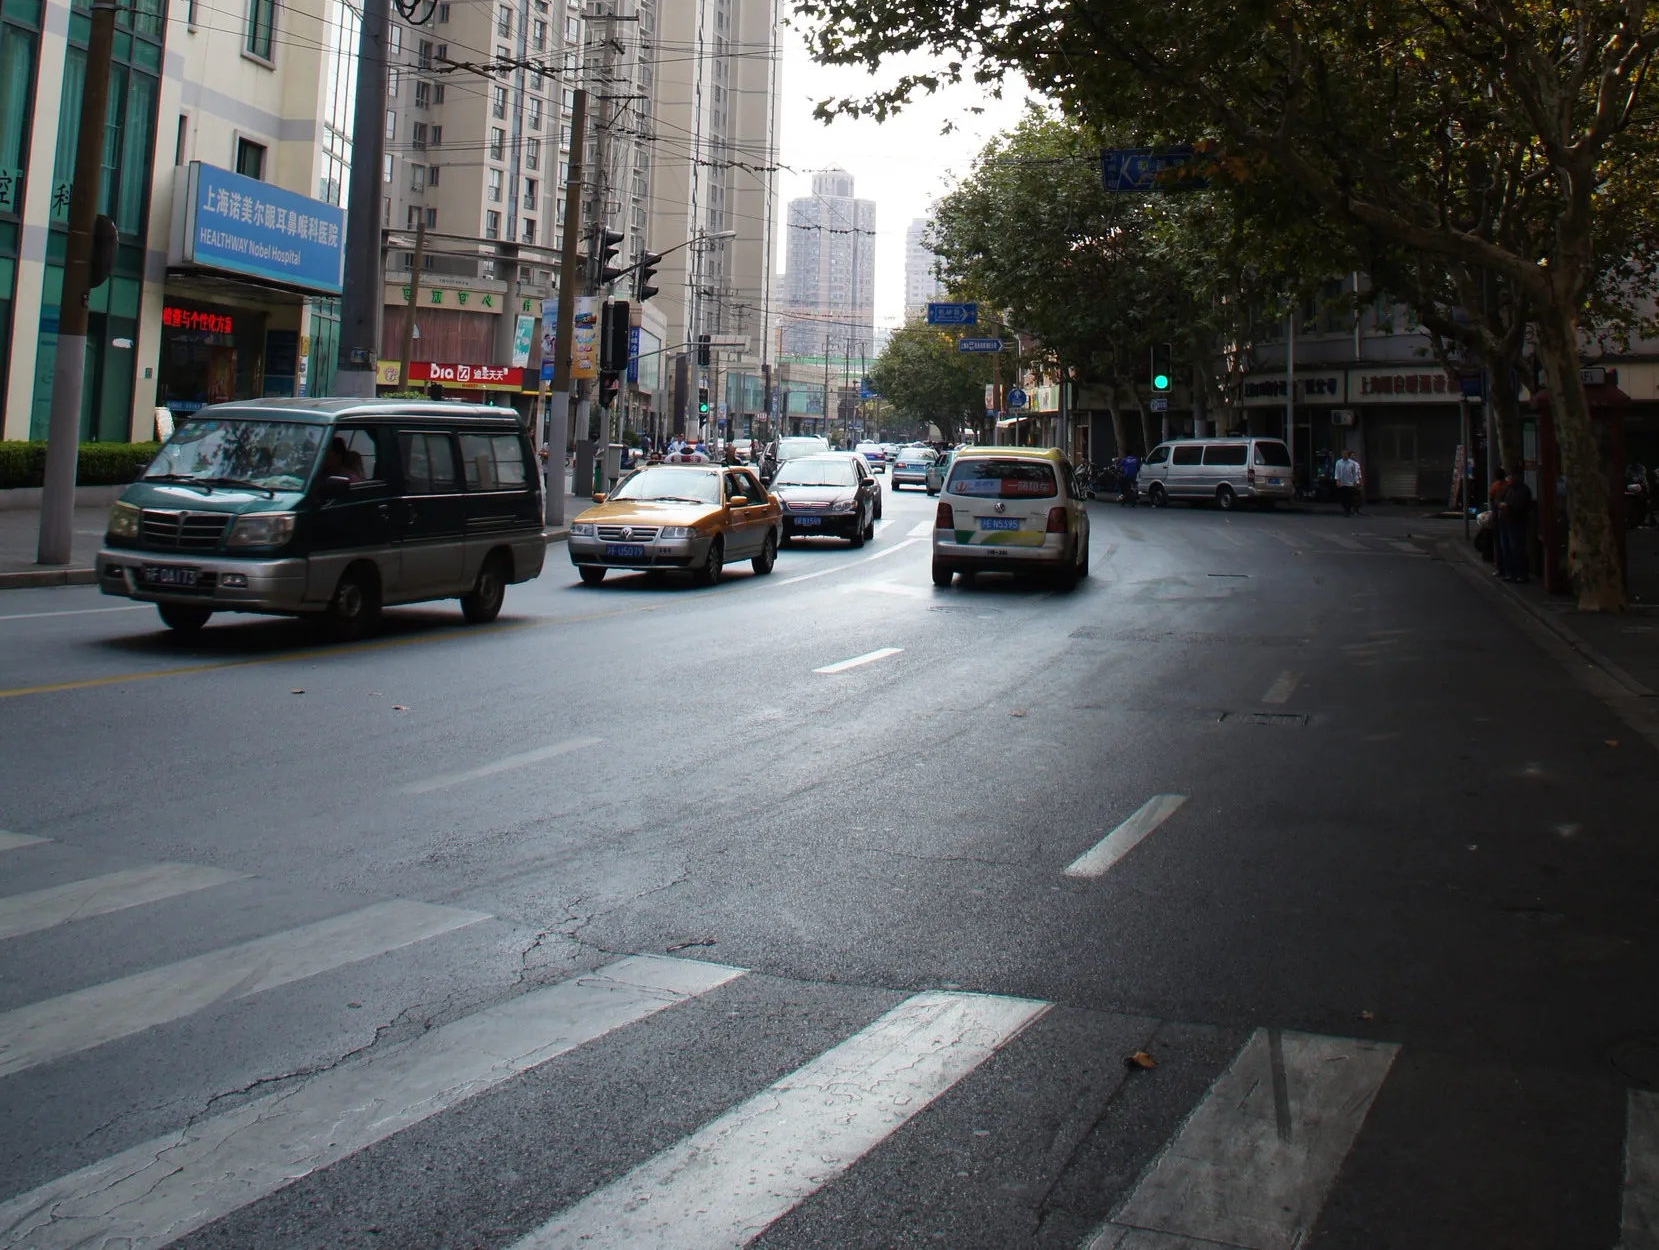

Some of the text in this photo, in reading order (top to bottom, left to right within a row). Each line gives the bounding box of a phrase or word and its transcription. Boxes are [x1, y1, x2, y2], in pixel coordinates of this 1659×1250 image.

[203, 185, 339, 248] 上海诺美尔眼耳鼻喉科医院
[200, 227, 301, 267] HEALTHWAY Nobel Hospital
